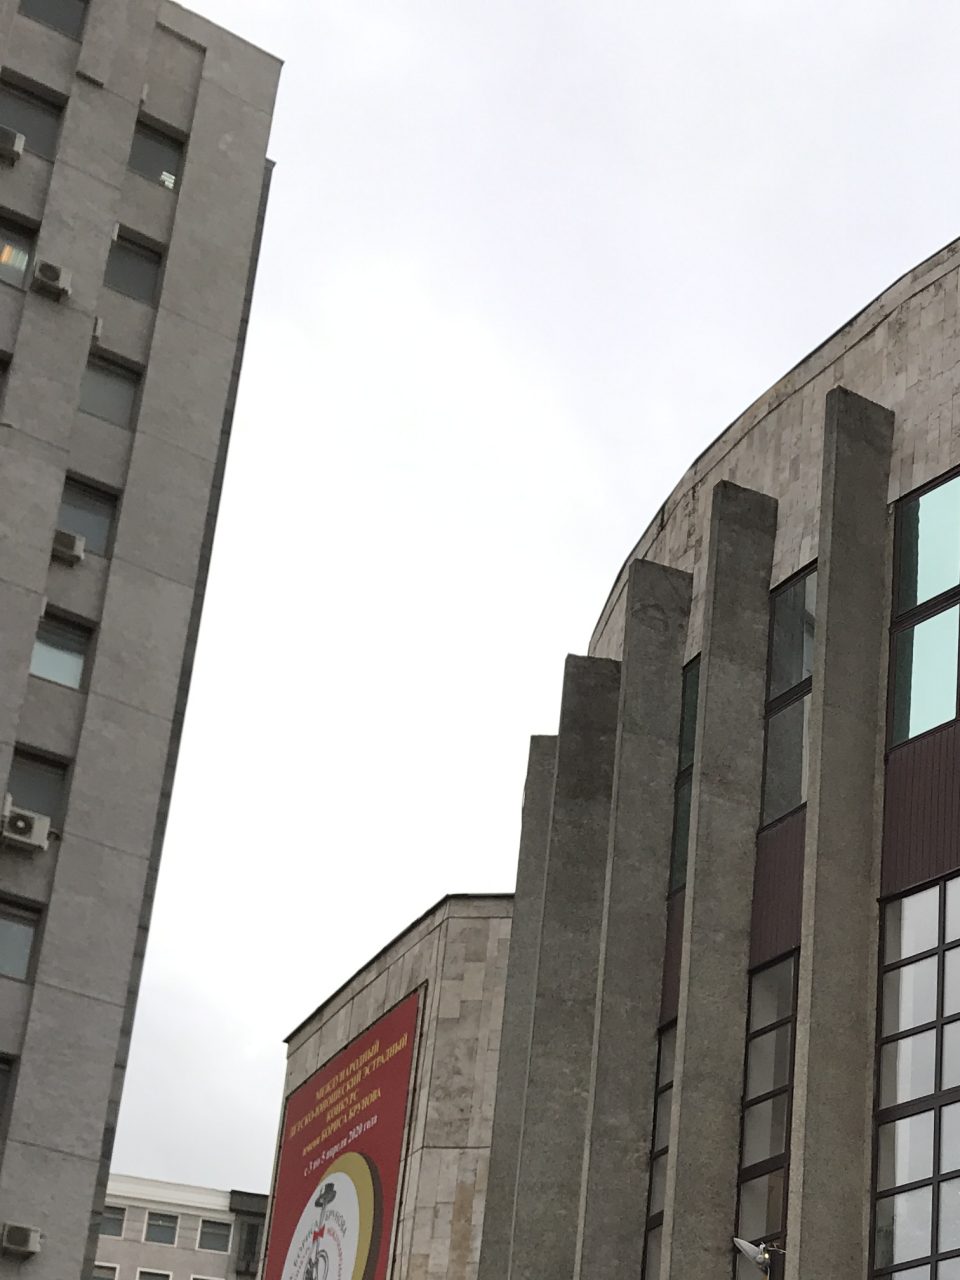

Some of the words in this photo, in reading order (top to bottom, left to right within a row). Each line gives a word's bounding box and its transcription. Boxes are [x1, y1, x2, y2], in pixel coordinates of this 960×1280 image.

[315, 1039, 380, 1100] МЕЖДУНАРОДНЫЙ
[363, 1032, 408, 1077] ЭСТРАДНЫЙ
[321, 1117, 347, 1145] БОРИСА
[348, 1087, 381, 1120] БРУНОВА
[326, 1089, 359, 1122] КОНКУРС
[326, 1138, 347, 1159] апреля
[348, 1123, 362, 1144] 2020
[363, 1115, 378, 1132] года
